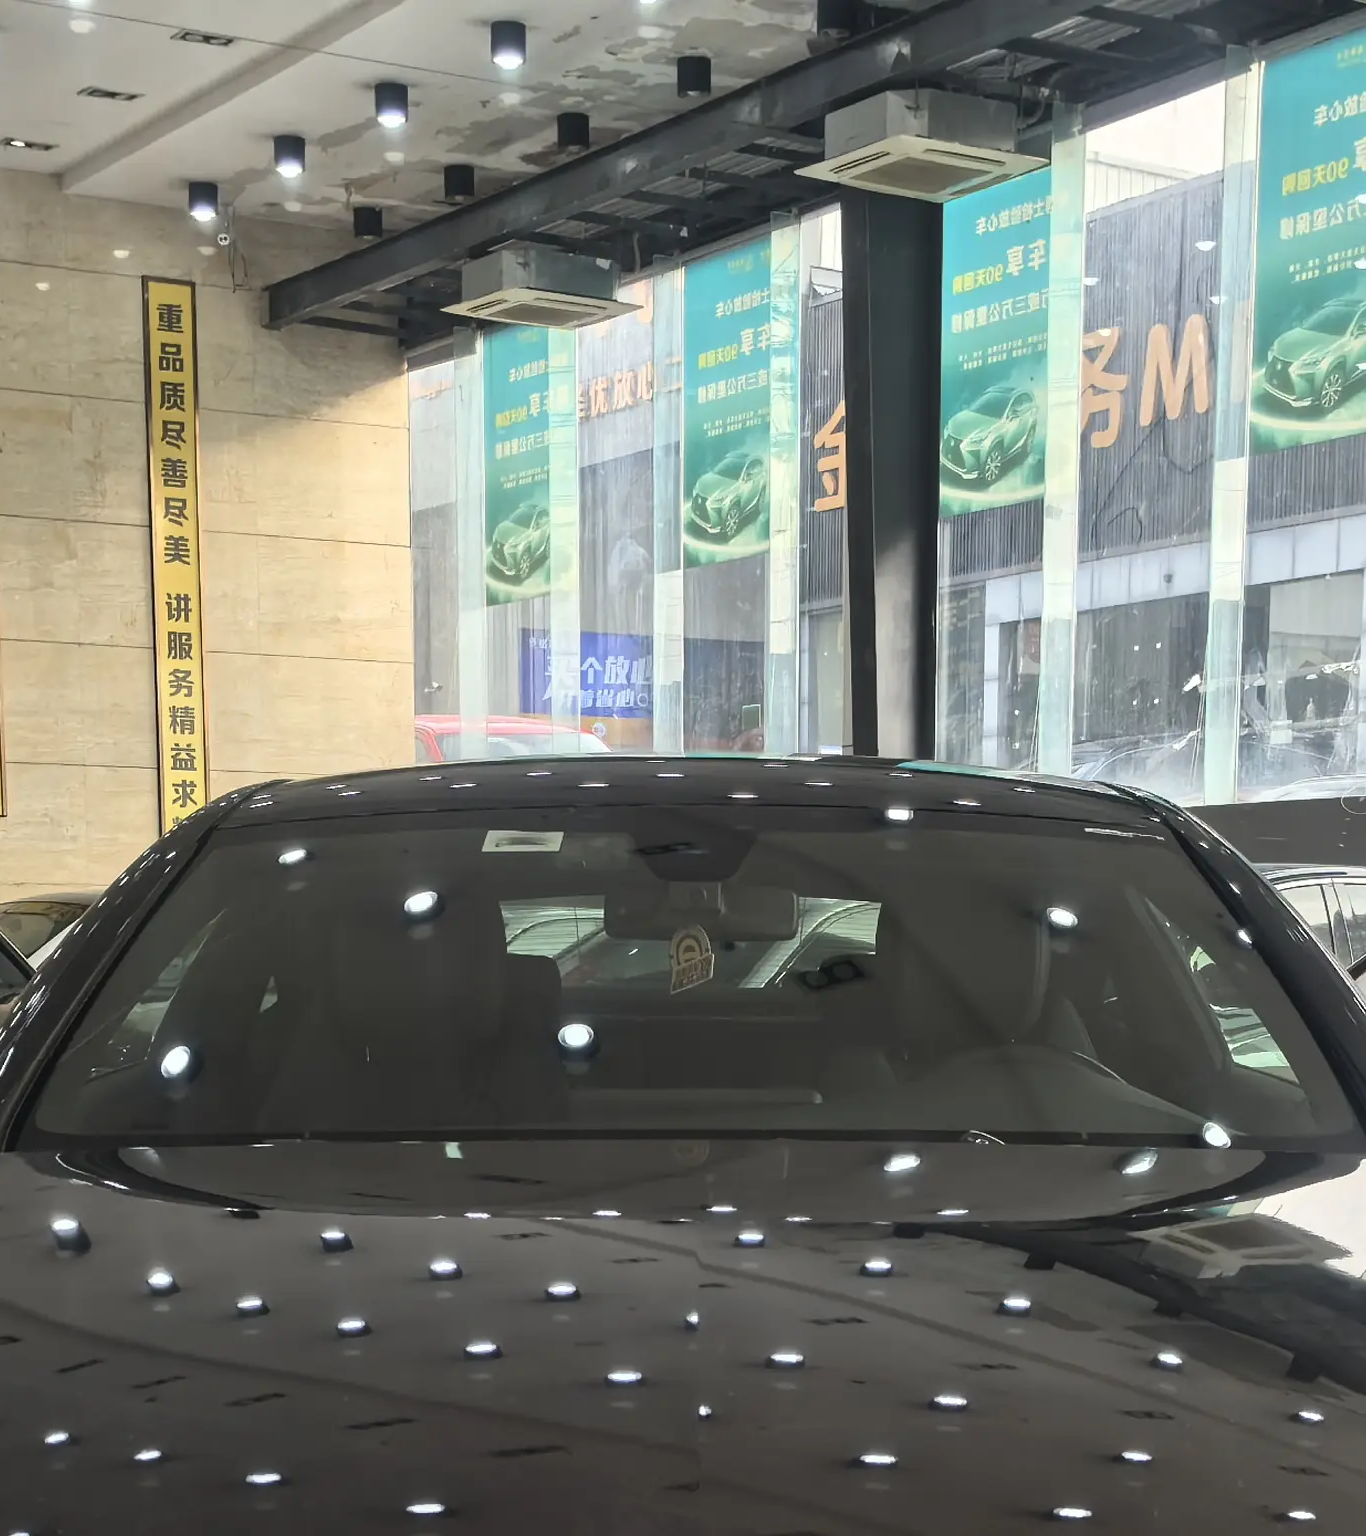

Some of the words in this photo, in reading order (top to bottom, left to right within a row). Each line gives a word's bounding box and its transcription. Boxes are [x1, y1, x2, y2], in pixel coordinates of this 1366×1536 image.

[156, 302, 192, 567] 重品质尽善尽美
[165, 592, 200, 824] 讲服务精益求
